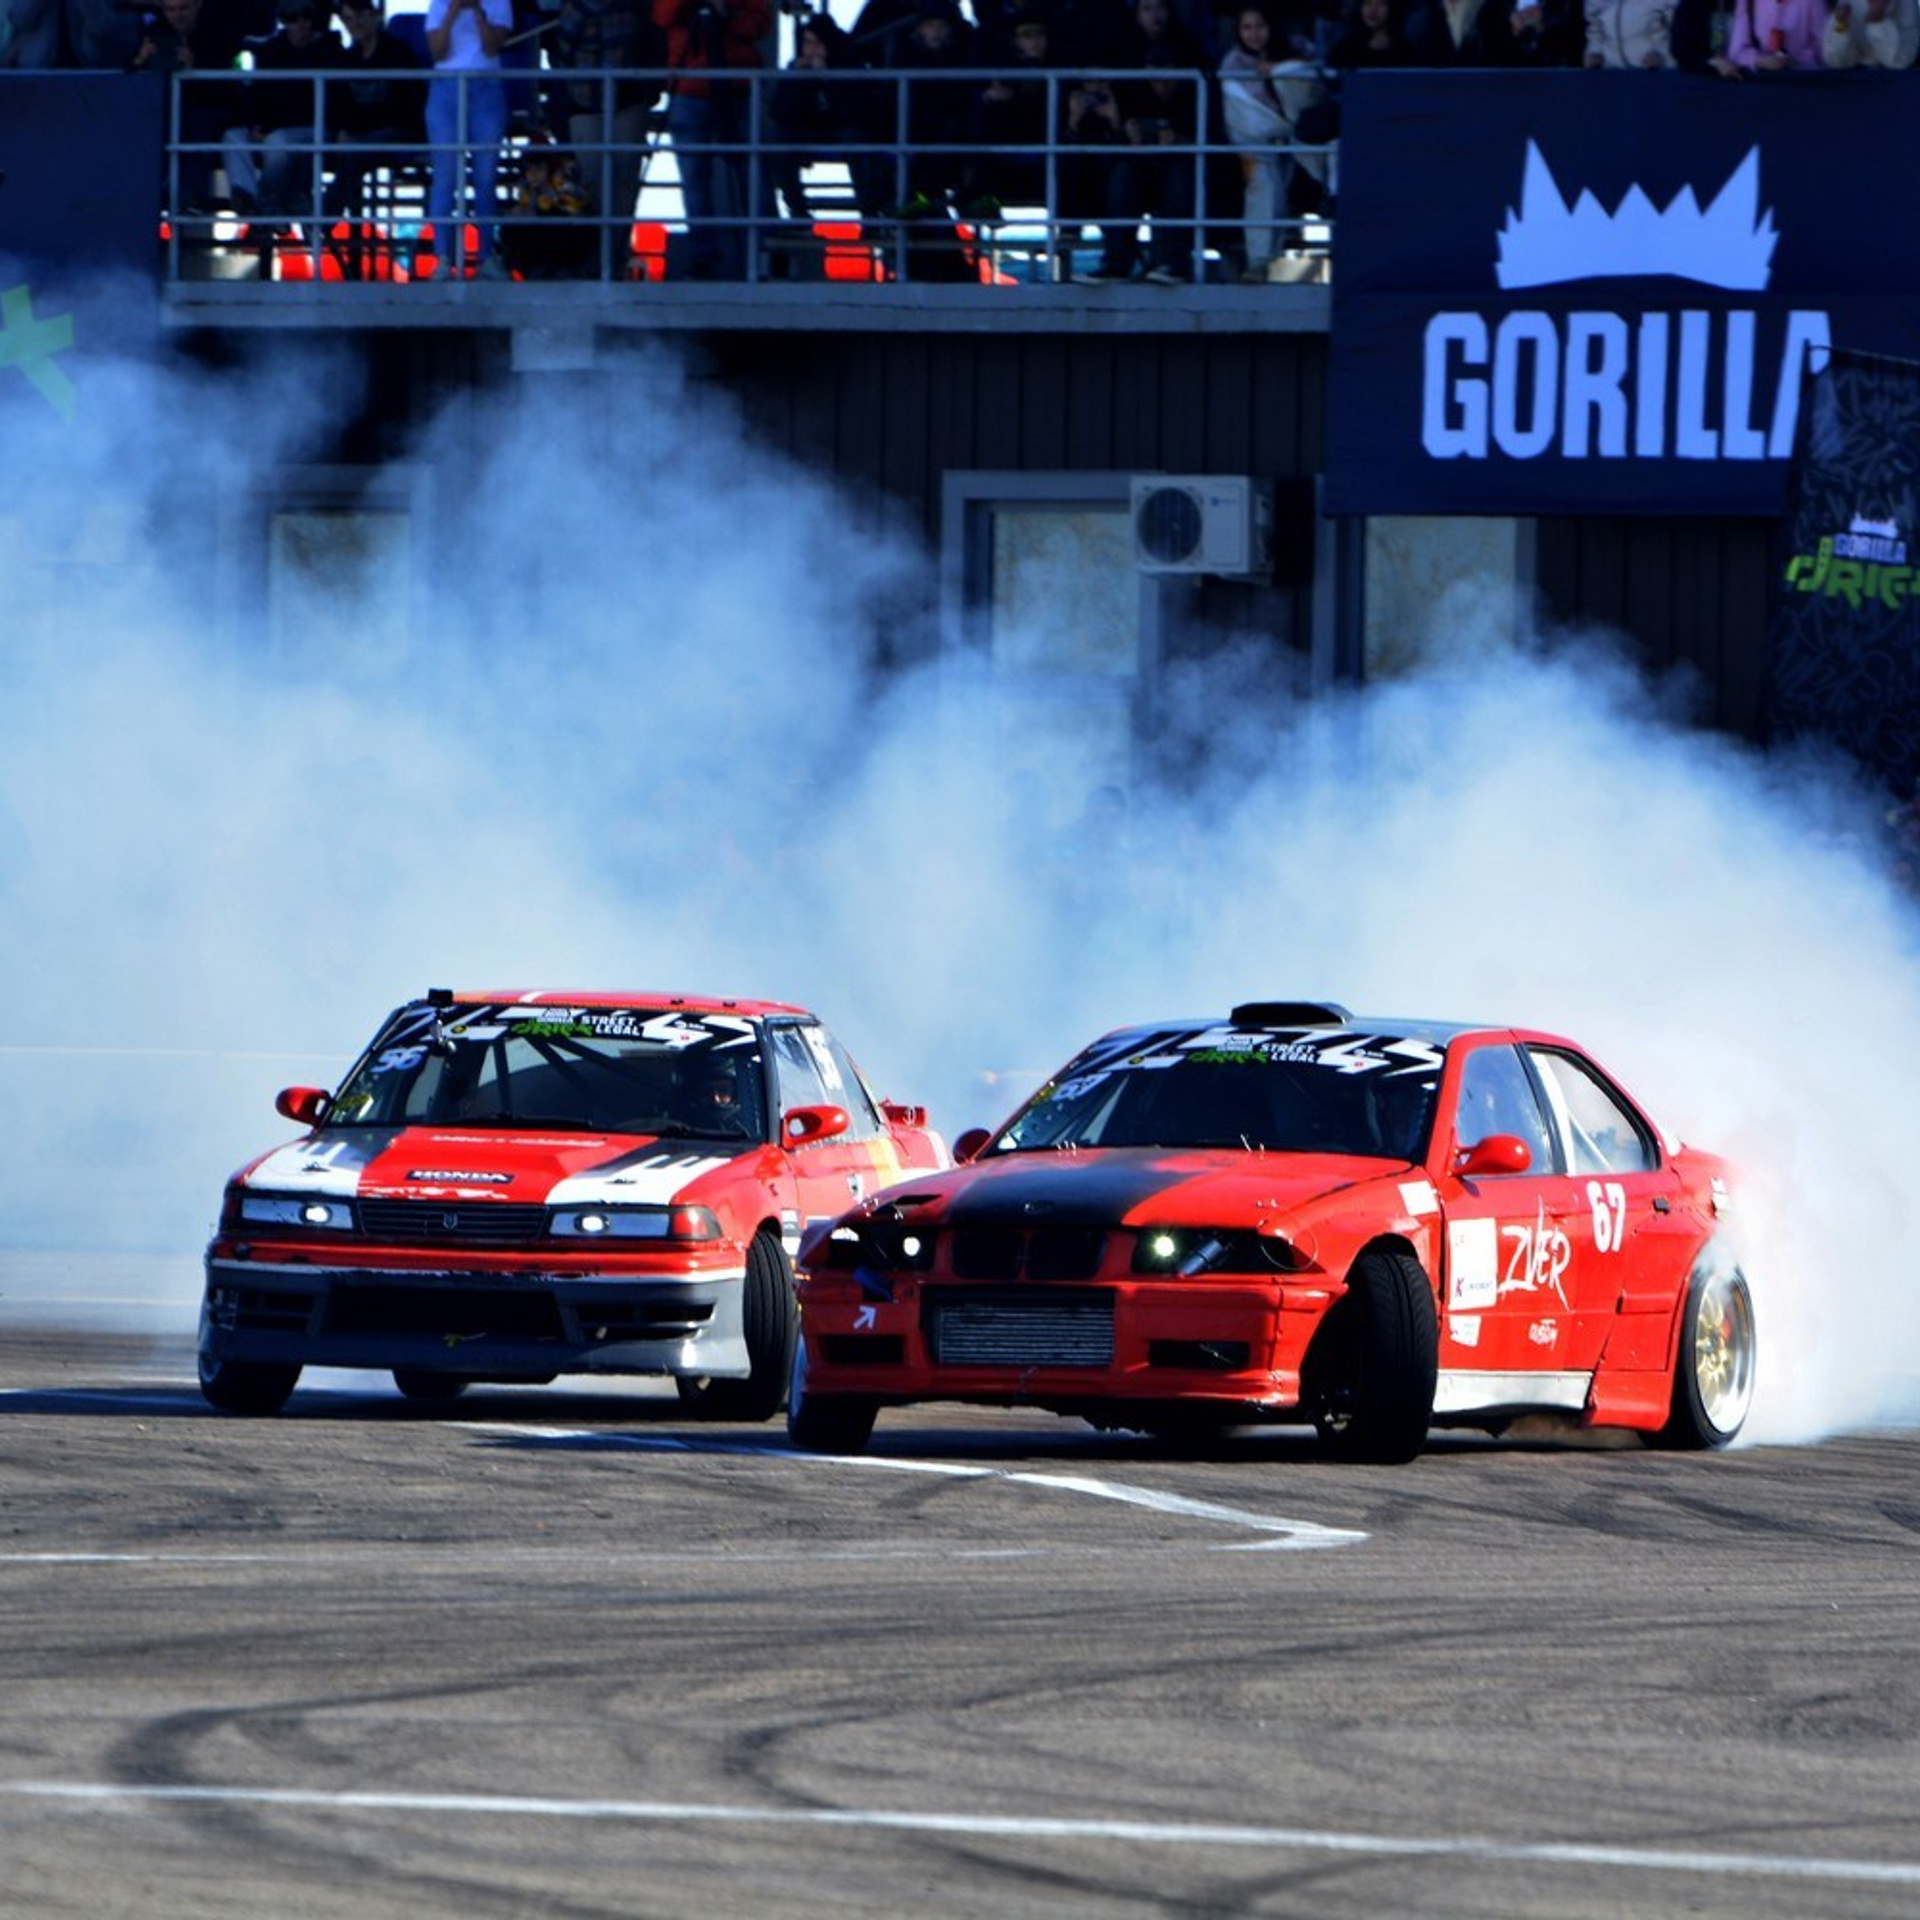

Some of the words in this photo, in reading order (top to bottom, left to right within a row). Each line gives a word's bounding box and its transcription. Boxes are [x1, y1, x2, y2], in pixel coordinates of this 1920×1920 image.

[1834, 533, 1907, 564] GORILLA
[1786, 536, 1920, 610] DRIF
[581, 1014, 637, 1027] STREET
[594, 1023, 641, 1037] LEGAL
[1260, 1042, 1317, 1054] STREET
[1271, 1051, 1316, 1064] LEGAL
[370, 1045, 428, 1073] 56
[412, 1169, 510, 1182] HONDA
[1587, 1181, 1626, 1253] 67
[1498, 1194, 1572, 1312] ZVER
